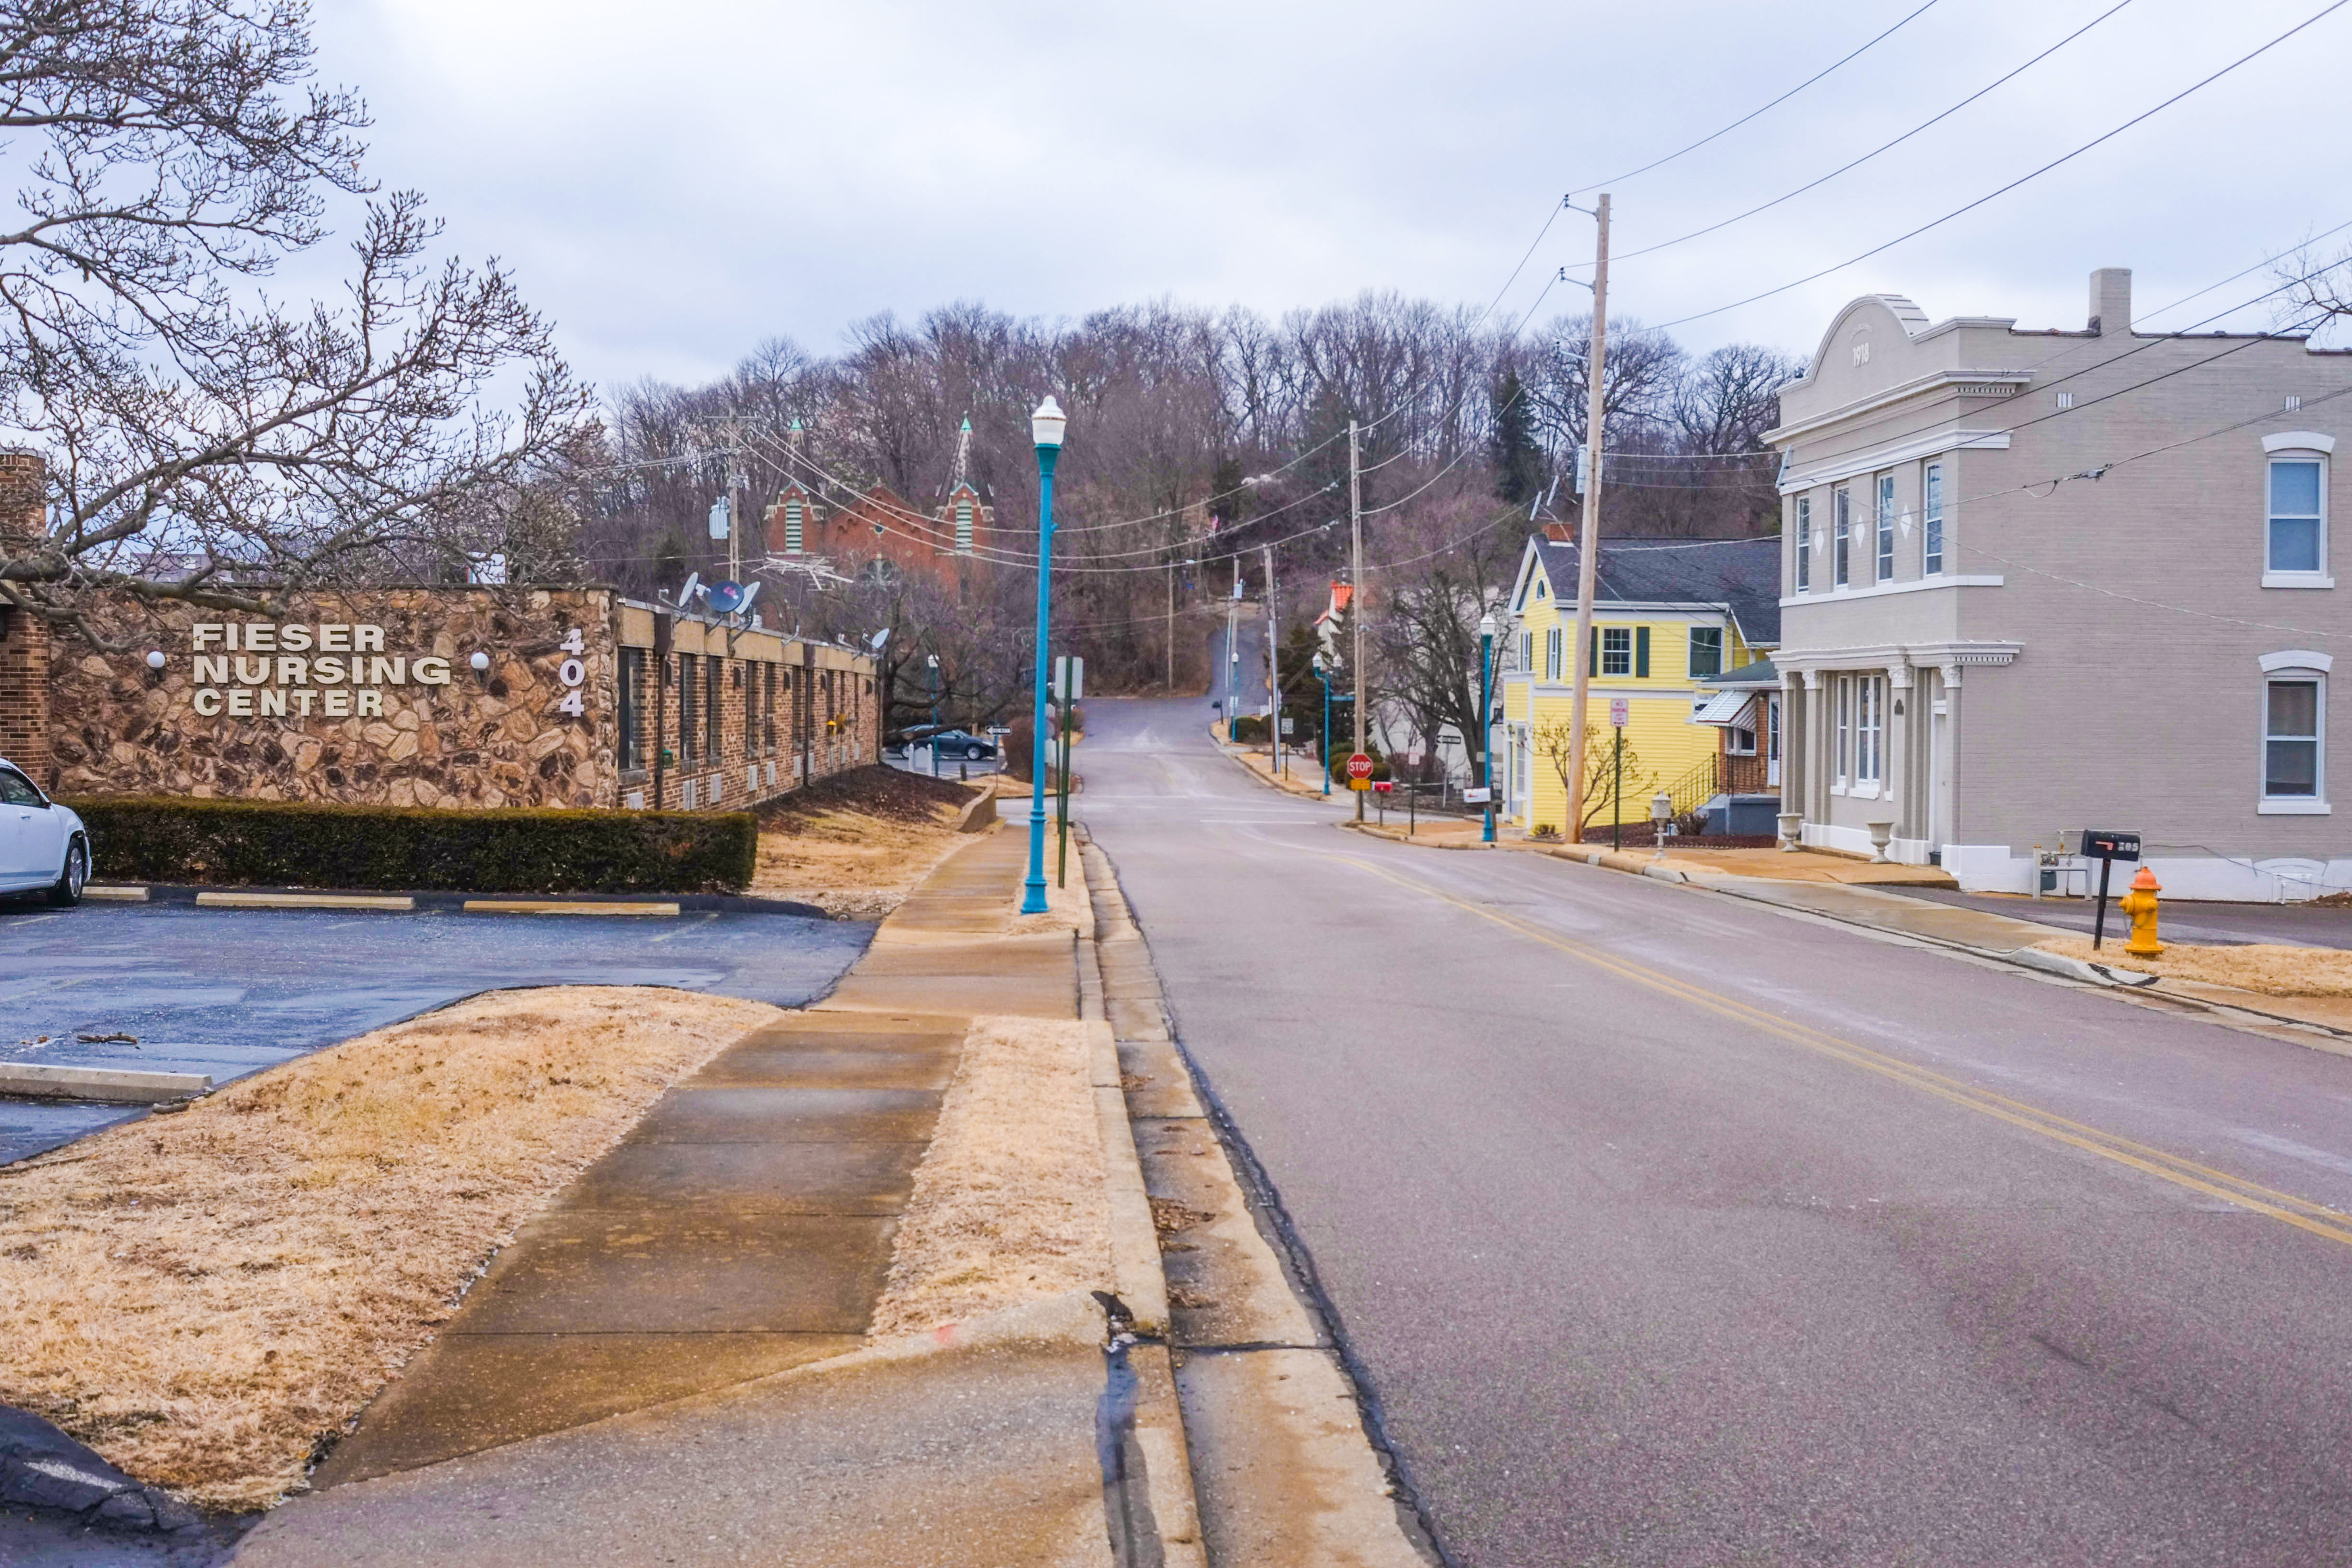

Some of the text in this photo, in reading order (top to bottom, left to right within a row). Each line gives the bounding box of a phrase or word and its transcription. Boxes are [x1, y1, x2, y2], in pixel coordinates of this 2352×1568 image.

[1853, 342, 1870, 367] 1918
[193, 623, 385, 652] FIESER
[194, 656, 451, 685] NURSING
[560, 628, 585, 717] 404
[194, 688, 383, 717] CENTER
[1349, 761, 1371, 772] STOP
